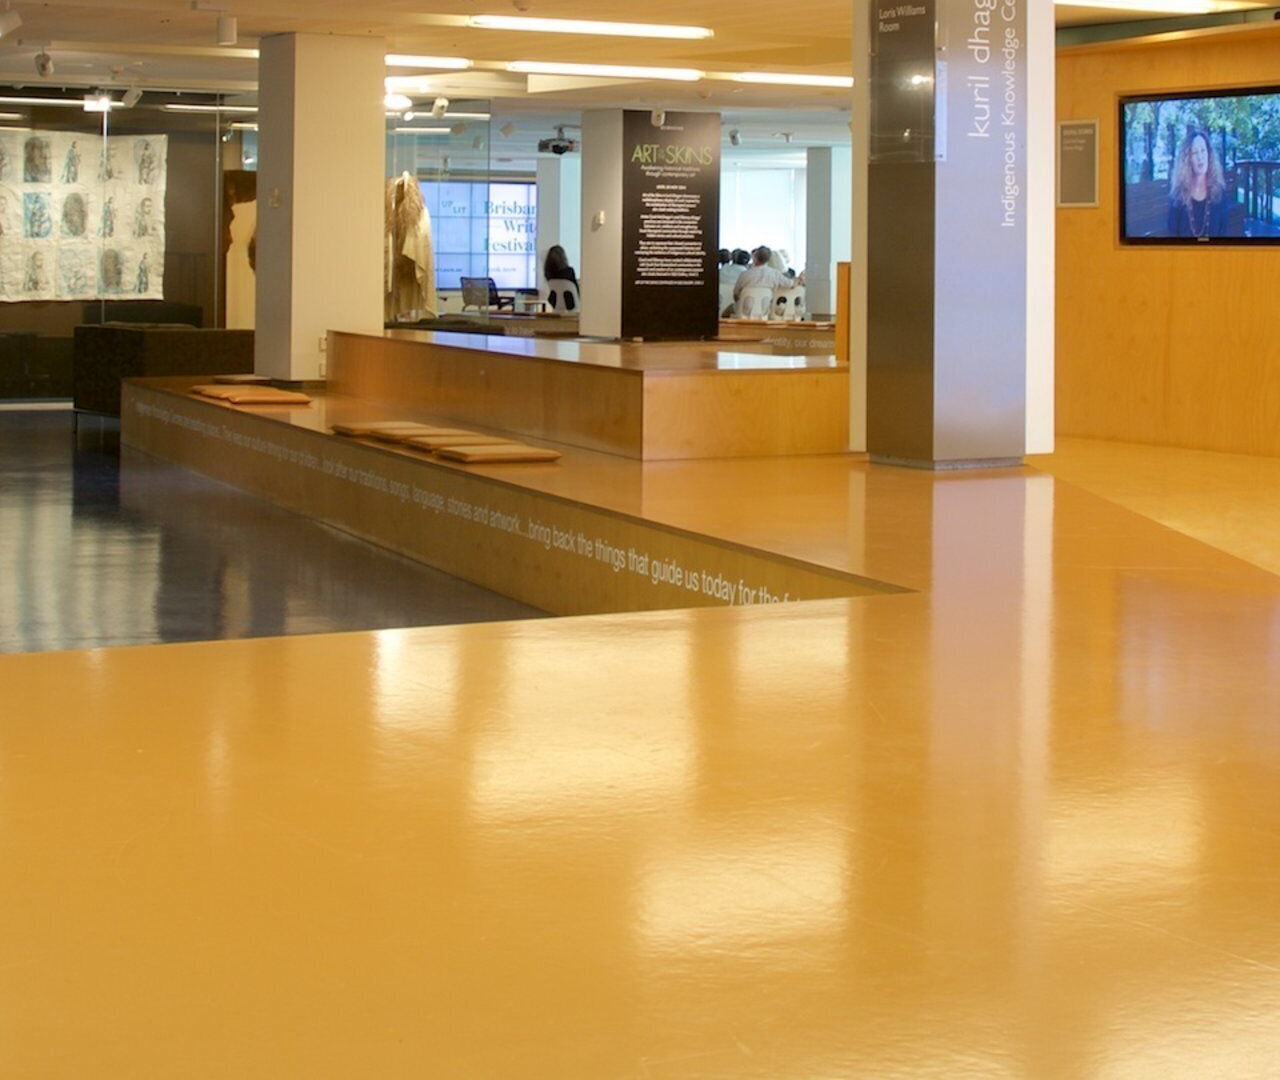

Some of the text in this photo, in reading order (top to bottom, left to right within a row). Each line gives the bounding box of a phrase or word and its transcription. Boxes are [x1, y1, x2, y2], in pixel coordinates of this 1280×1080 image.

[967, 75, 990, 137] kuril
[1001, 27, 1020, 126] Knowledge
[631, 143, 660, 163] ART
[665, 144, 713, 166] SKINS
[1001, 131, 1020, 227] Indigenous
[473, 503, 489, 526] and
[553, 524, 576, 553] back
[577, 532, 594, 558] the
[595, 538, 626, 572] things
[628, 547, 649, 577] that
[651, 557, 683, 586] guide
[685, 571, 700, 592] us
[701, 568, 737, 607] today
[738, 579, 756, 606] for
